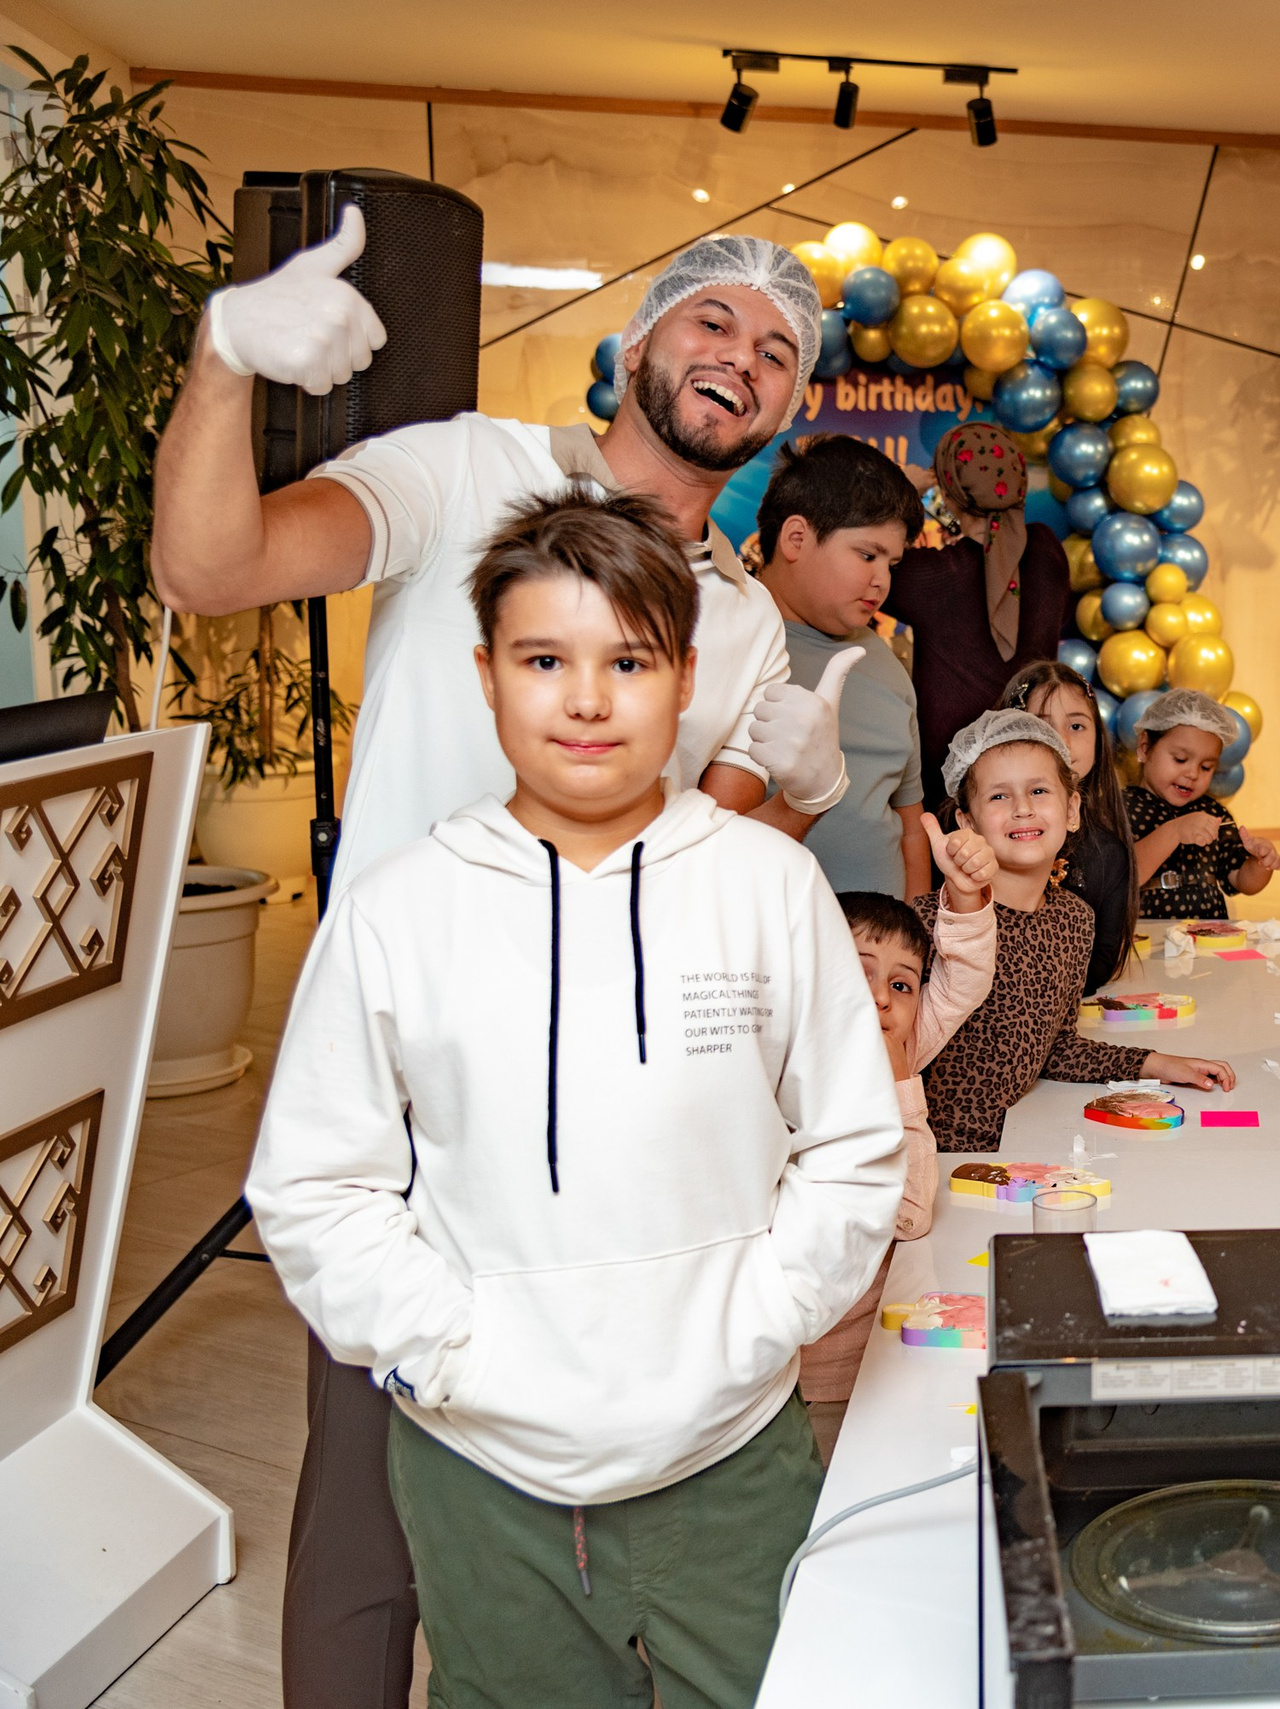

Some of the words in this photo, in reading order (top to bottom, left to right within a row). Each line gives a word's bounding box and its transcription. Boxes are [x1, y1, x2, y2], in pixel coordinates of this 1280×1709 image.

[680, 974, 701, 983] THE
[703, 972, 738, 982] WORLD
[741, 972, 750, 981] IS
[683, 990, 731, 1001] MAGICAL
[684, 1007, 738, 1019] PATIENTLY
[685, 1027, 708, 1038] OUR
[709, 1025, 736, 1036] WITS
[737, 1024, 750, 1035] TO
[686, 1043, 732, 1056] SHARPER
